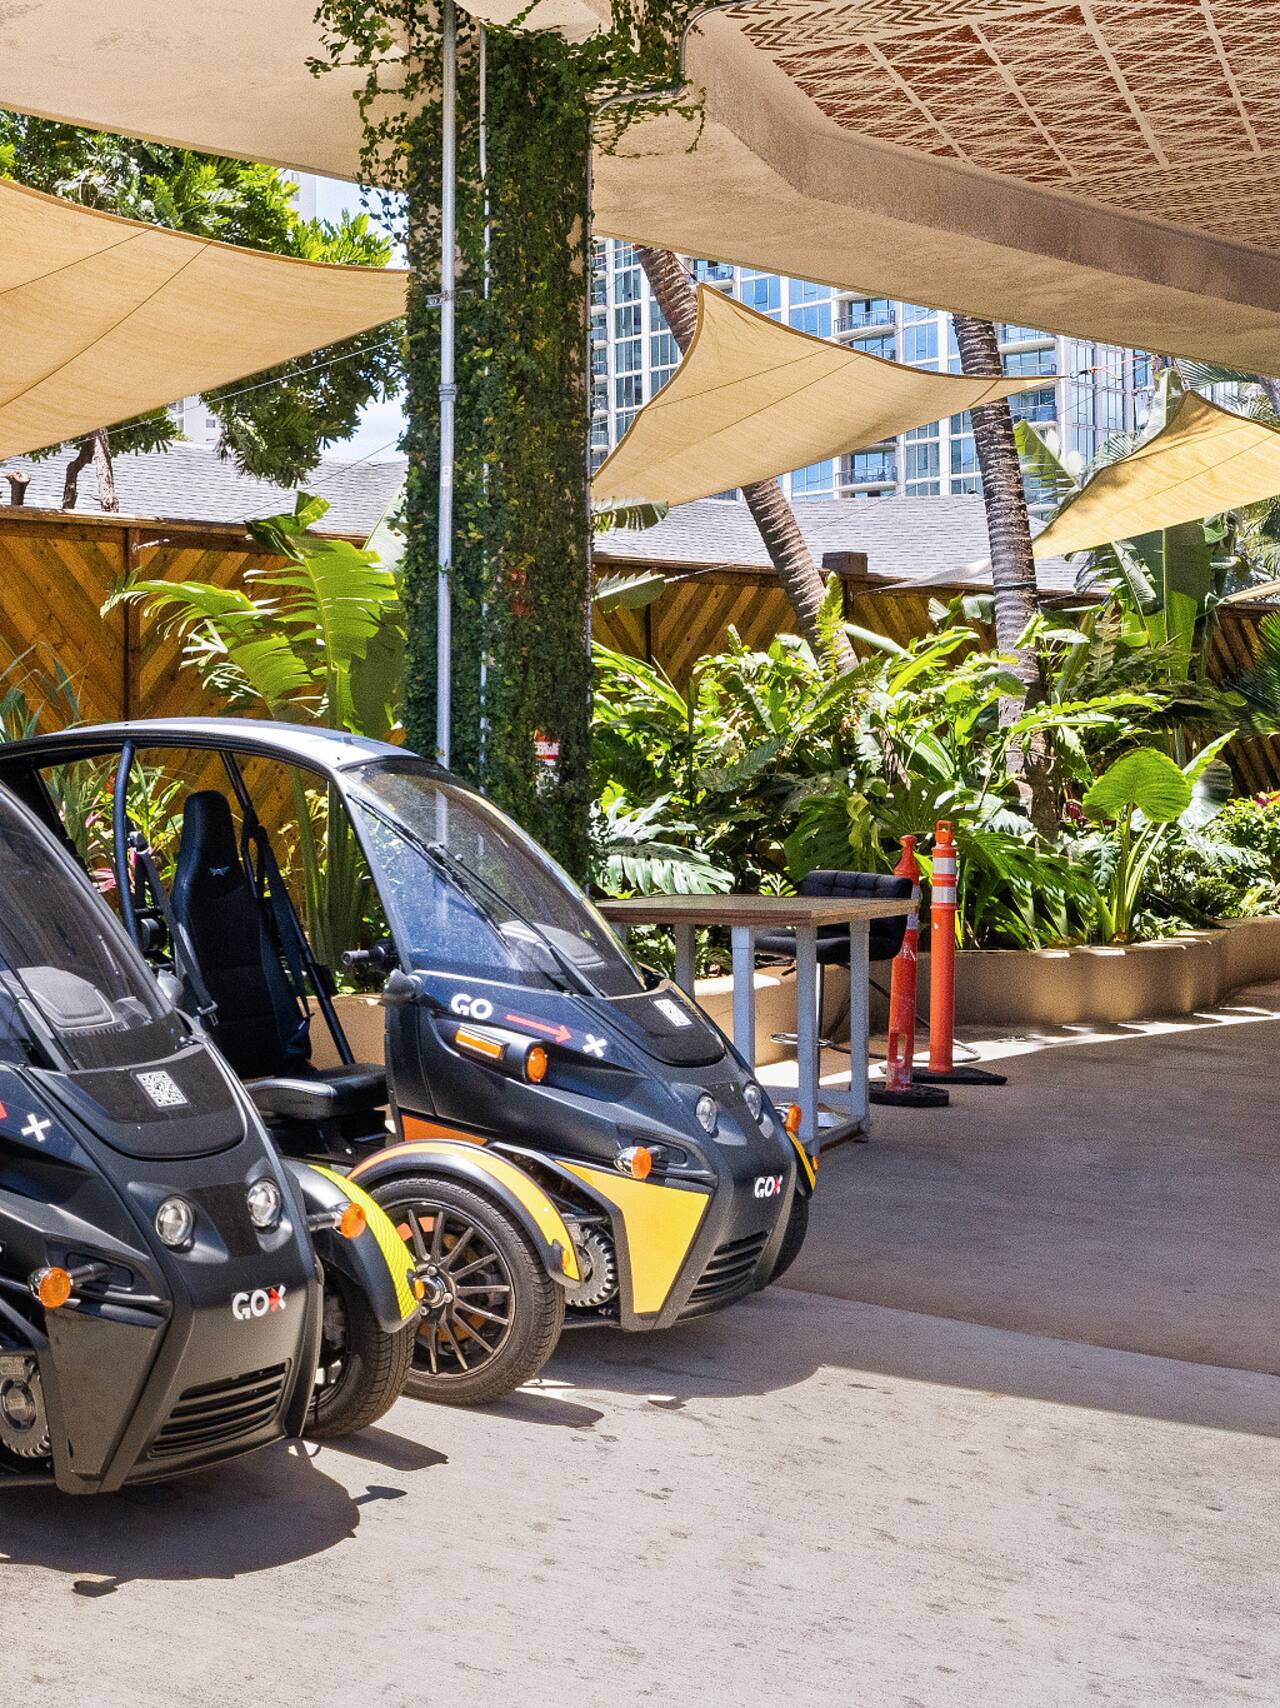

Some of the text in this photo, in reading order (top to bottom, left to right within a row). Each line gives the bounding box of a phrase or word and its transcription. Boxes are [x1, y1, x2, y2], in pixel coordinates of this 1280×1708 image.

[451, 993, 608, 1058] GO X
[21, 1113, 52, 1142] X
[232, 1284, 287, 1320] GOX
